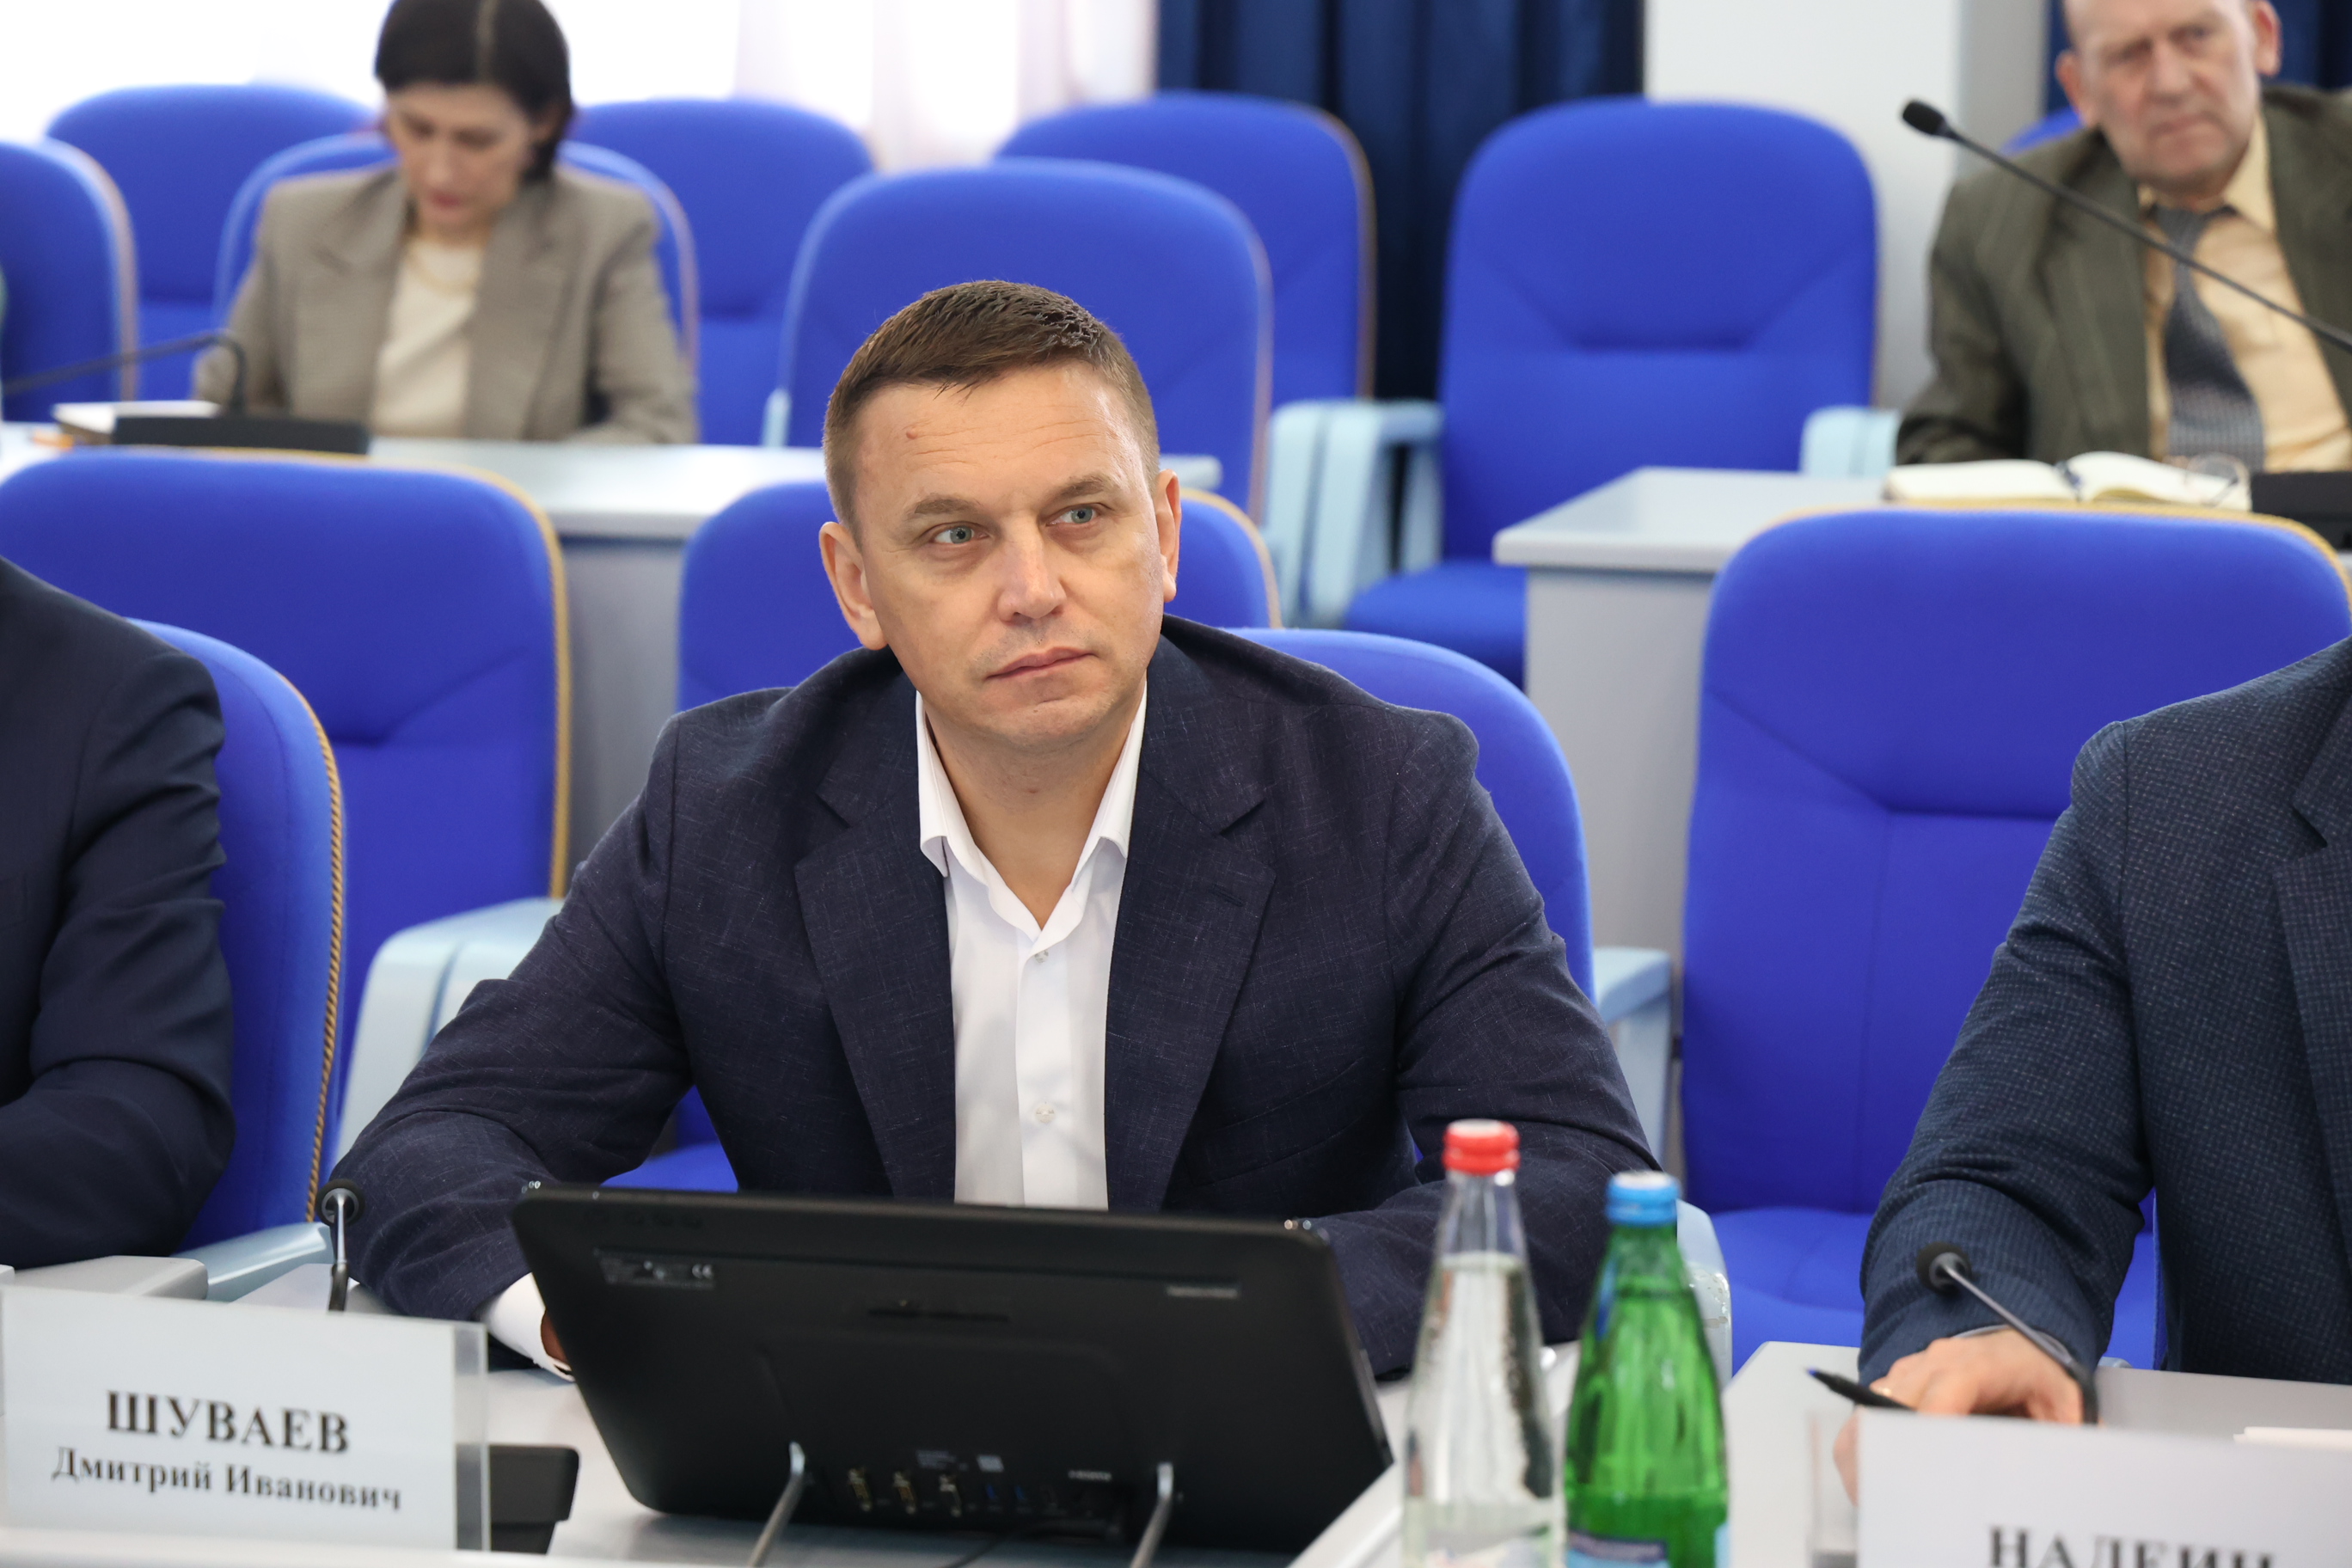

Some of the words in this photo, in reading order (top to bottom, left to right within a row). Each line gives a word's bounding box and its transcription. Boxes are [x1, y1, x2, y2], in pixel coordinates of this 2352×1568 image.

[107, 1390, 350, 1453] ШУВАЕВ
[52, 1446, 211, 1493] Дмитрий
[226, 1463, 401, 1510] Иванович
